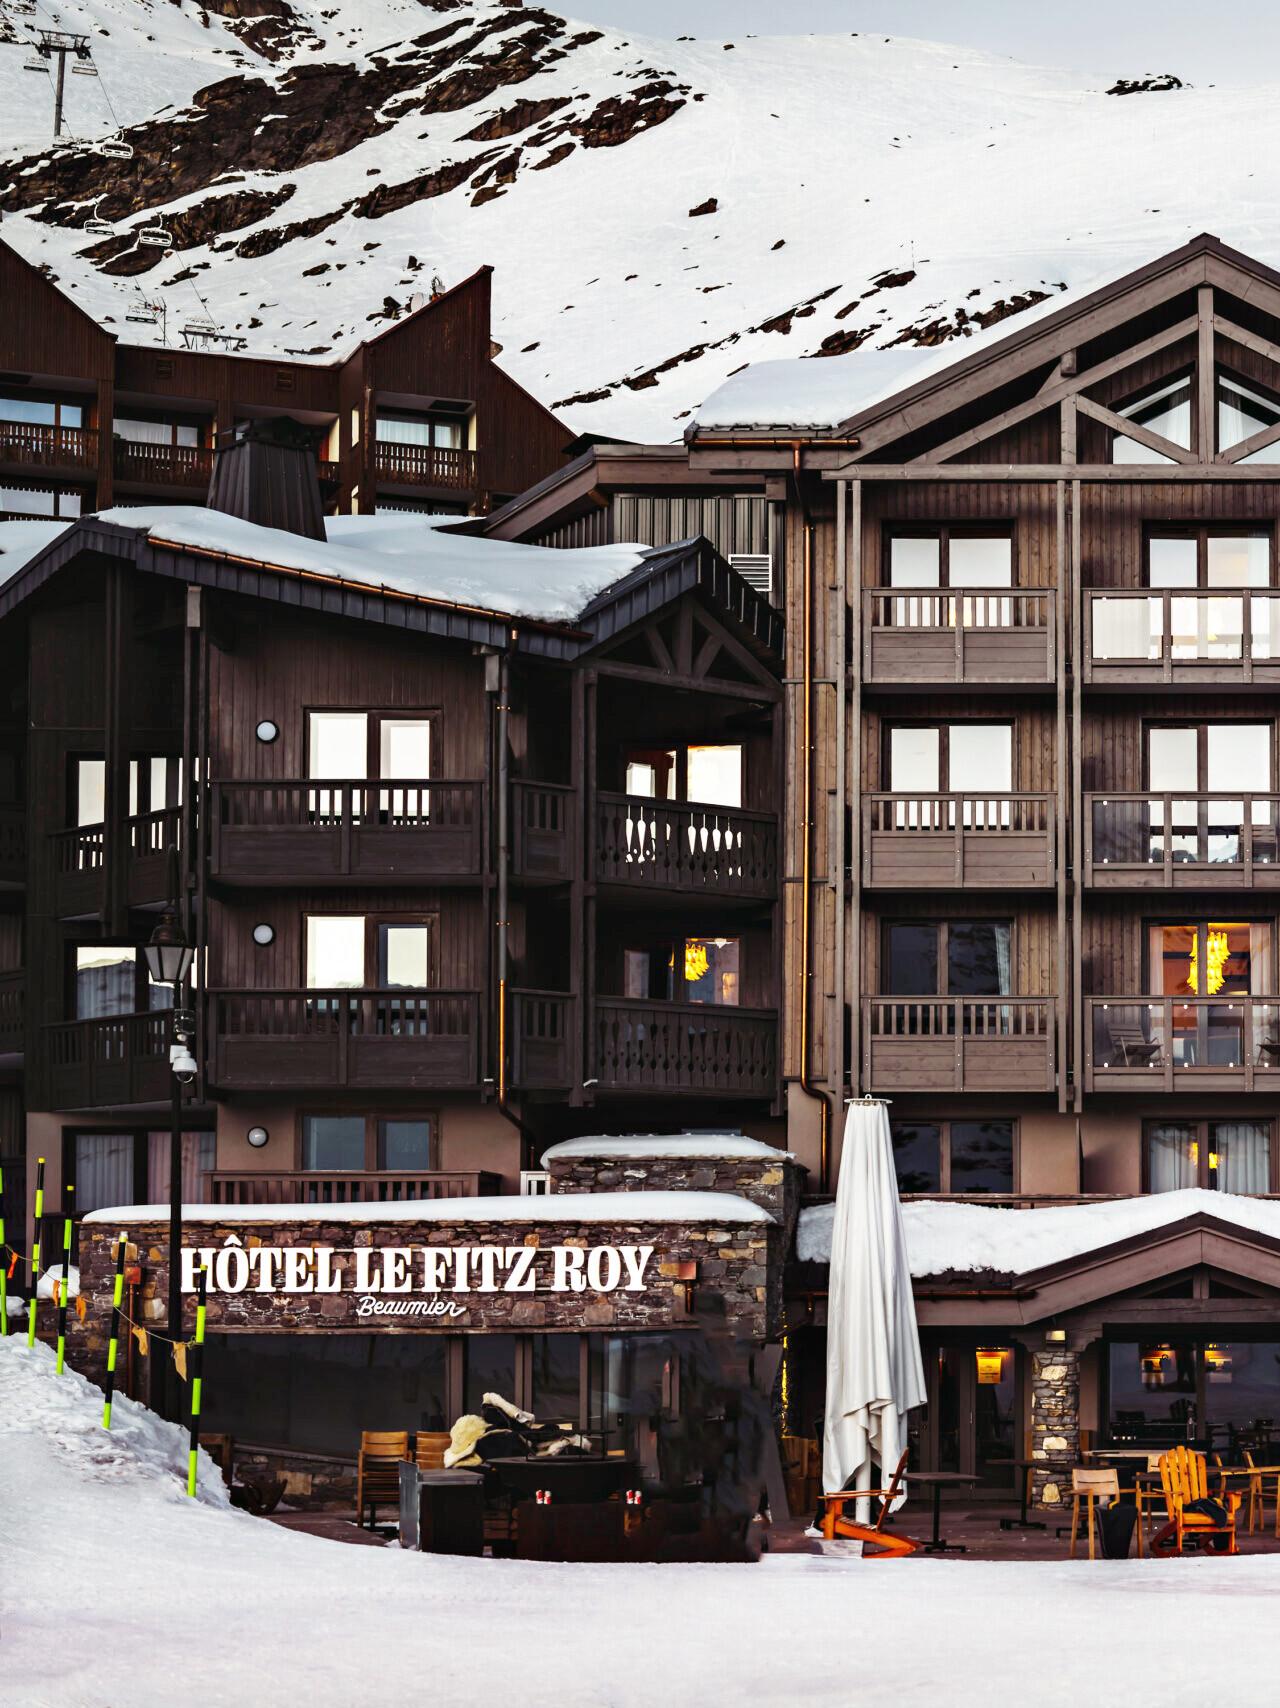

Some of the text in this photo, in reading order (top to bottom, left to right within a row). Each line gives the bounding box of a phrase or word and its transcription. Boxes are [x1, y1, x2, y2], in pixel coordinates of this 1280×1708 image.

[180, 1233, 654, 1294] HÔTEL LE FITZ ROY
[356, 1296, 467, 1318] Beaumier
